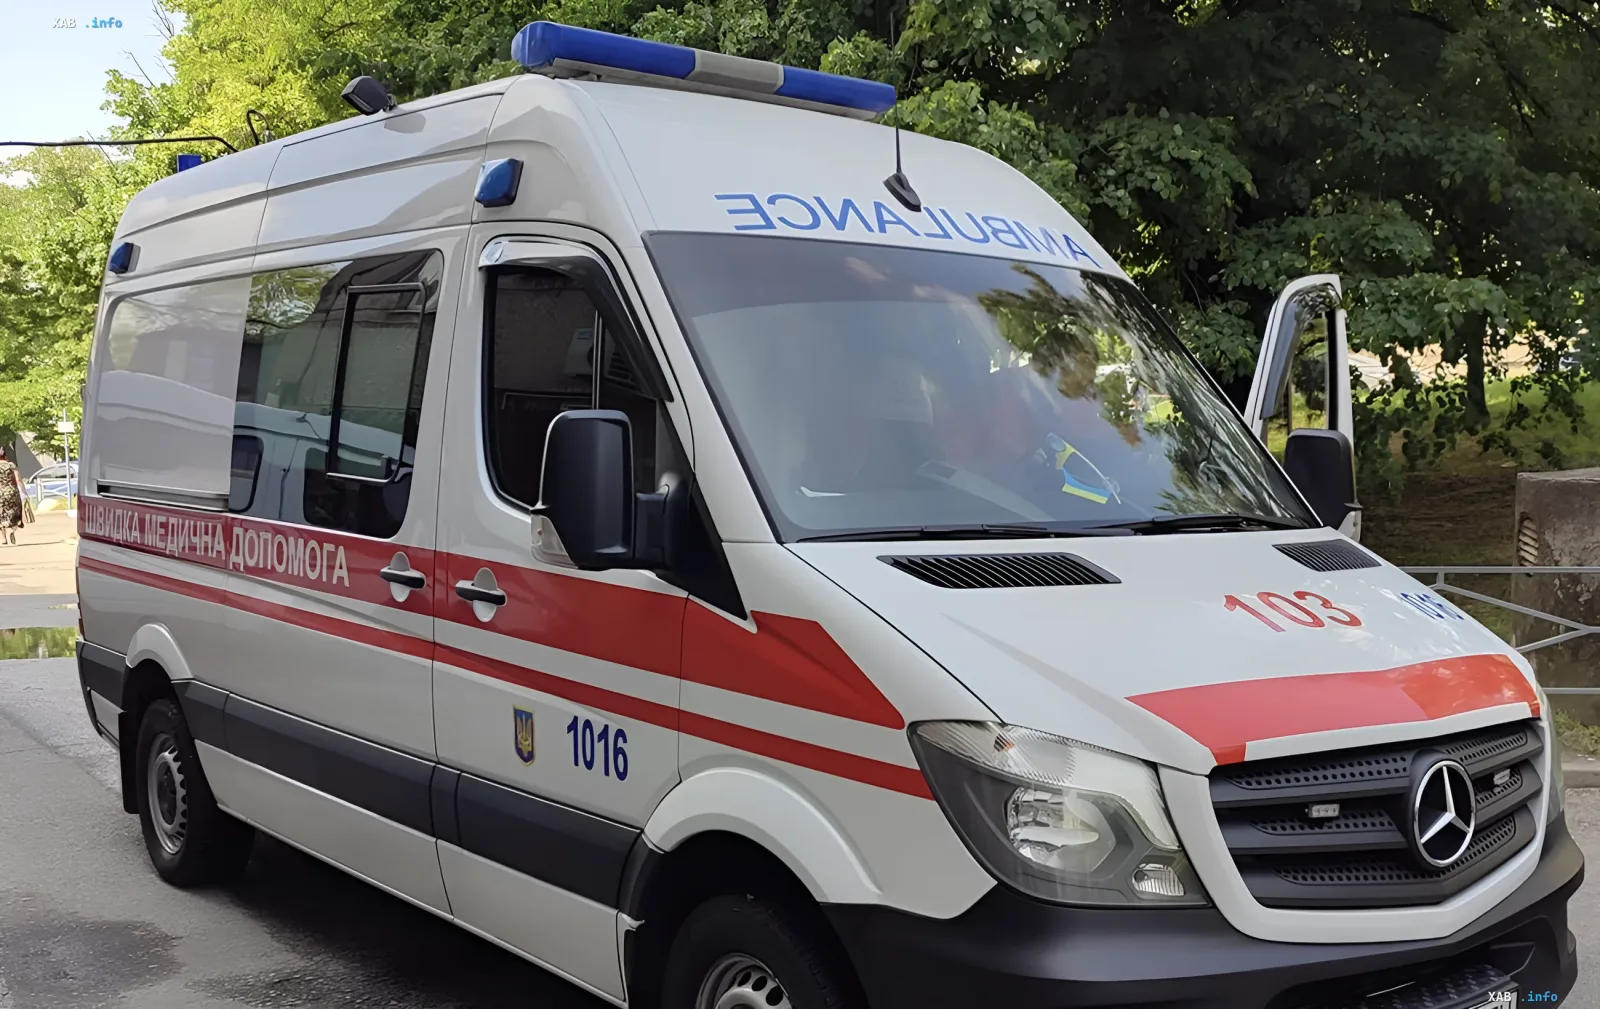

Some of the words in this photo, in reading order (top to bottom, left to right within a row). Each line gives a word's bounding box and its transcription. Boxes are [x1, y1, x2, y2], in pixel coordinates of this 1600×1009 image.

[85, 503, 140, 543] ШВИДКА
[144, 513, 226, 560] МЕДИЧНА
[229, 527, 350, 588] ДОПОМОГА
[1223, 590, 1363, 633] 103
[567, 715, 628, 781] 1016
